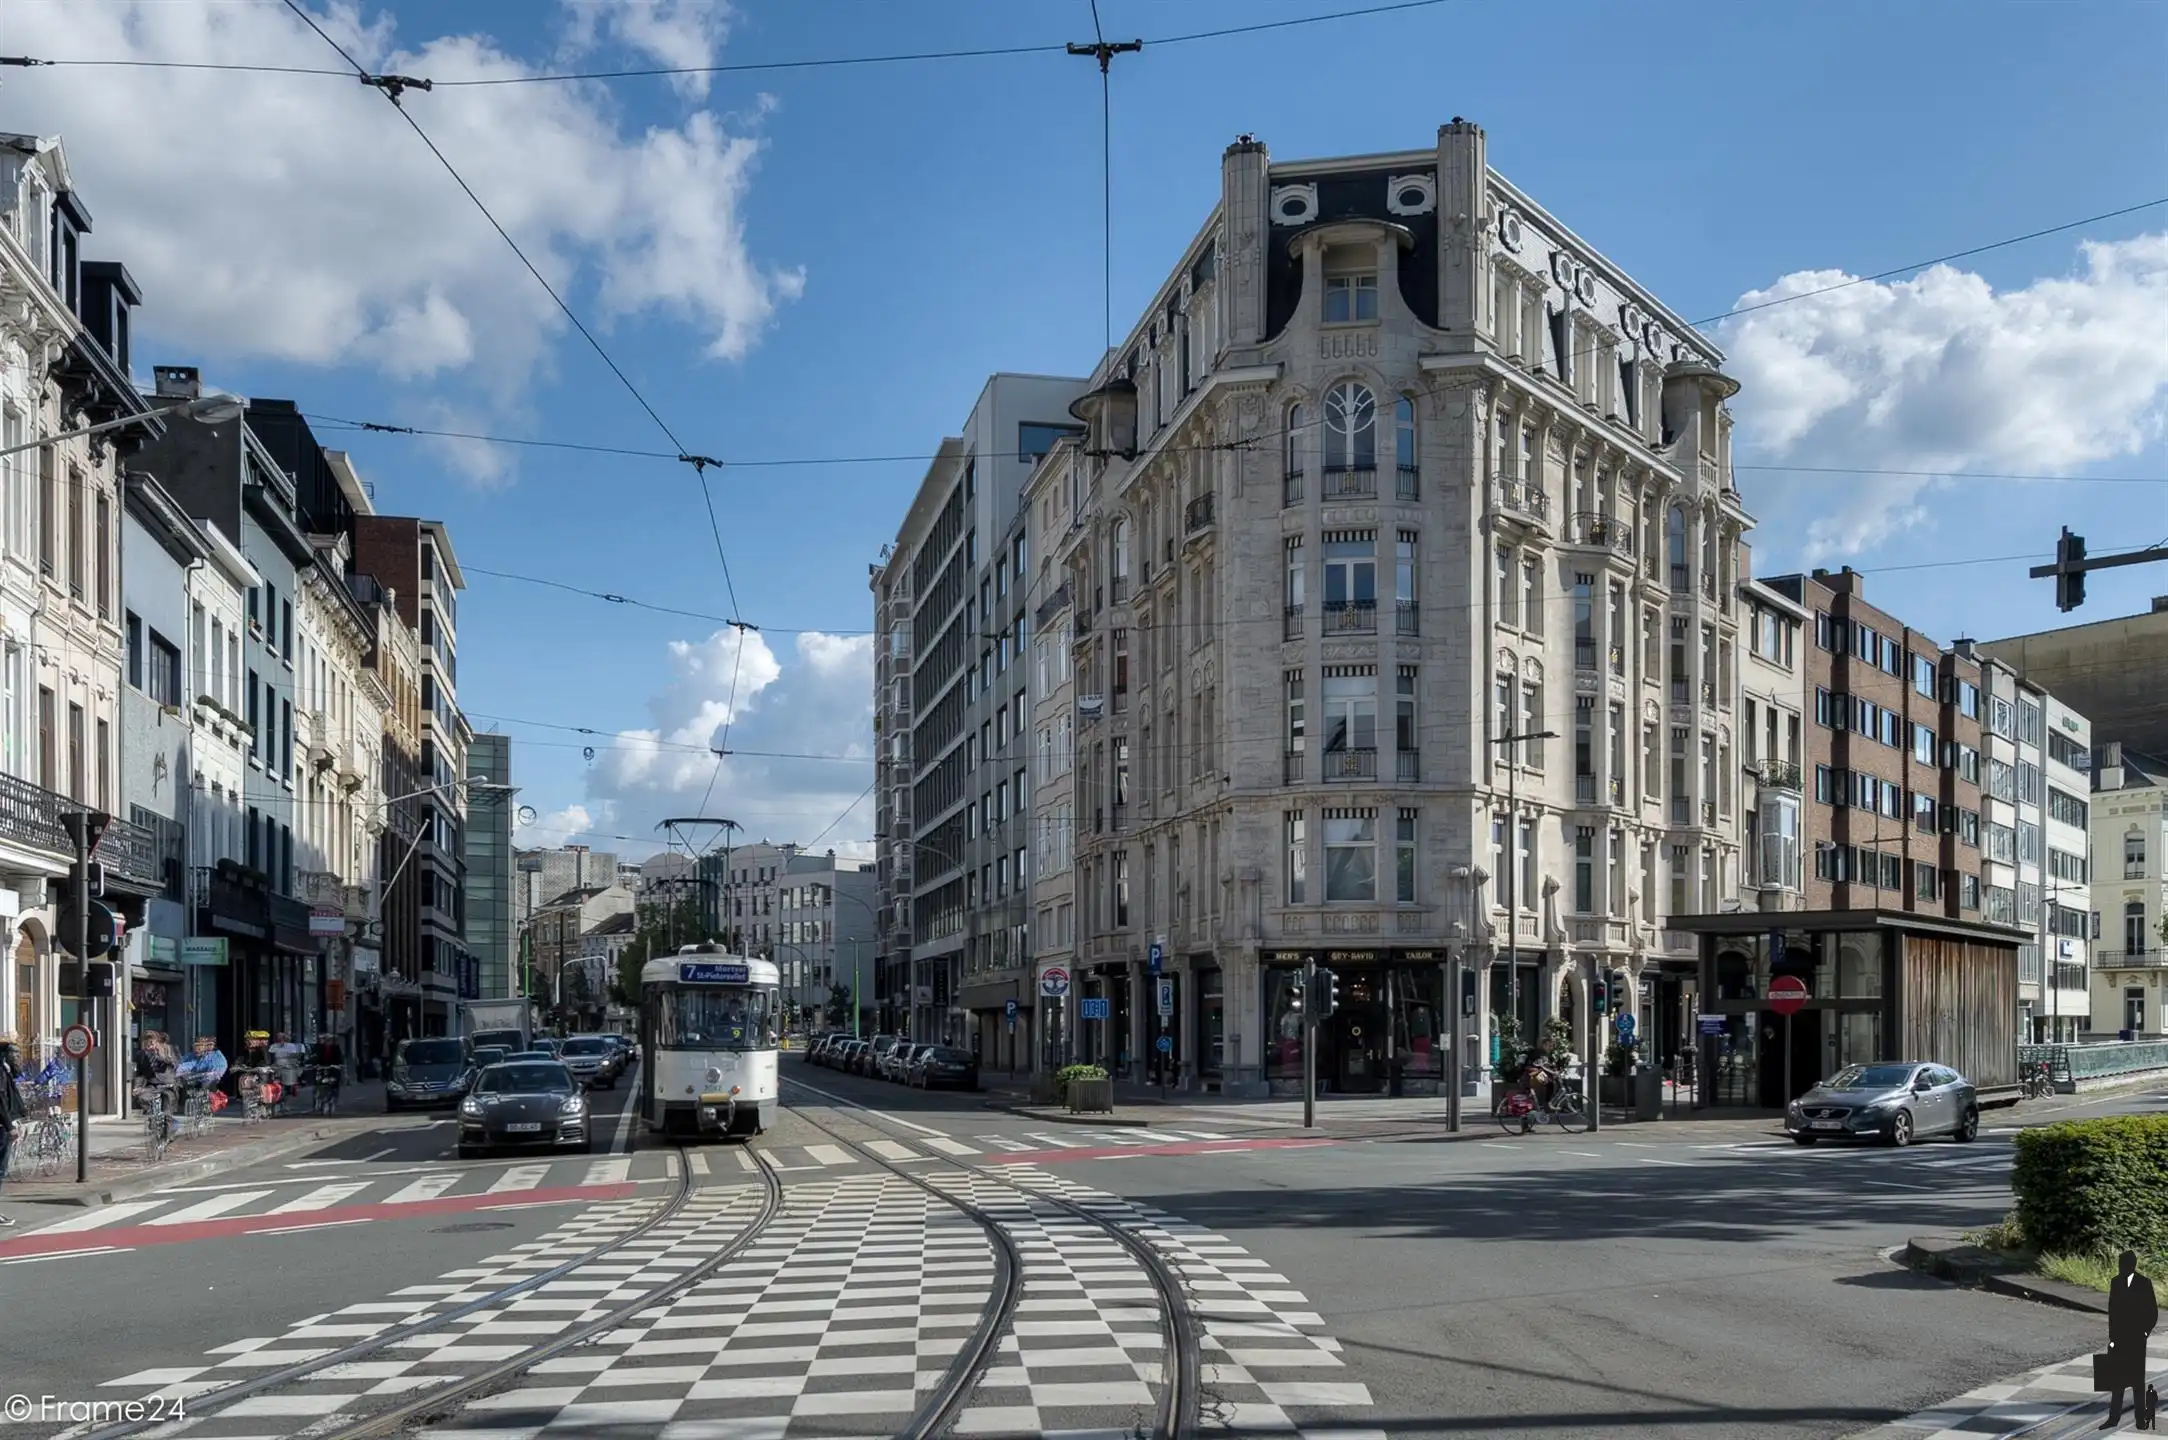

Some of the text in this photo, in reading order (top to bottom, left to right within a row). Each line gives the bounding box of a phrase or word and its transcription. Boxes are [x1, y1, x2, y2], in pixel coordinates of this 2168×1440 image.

[1151, 948, 1160, 965] P
[1405, 951, 1433, 960] TAILOR
[686, 964, 697, 980] 7
[1007, 1001, 1016, 1015] P
[732, 1029, 741, 1039] 9
